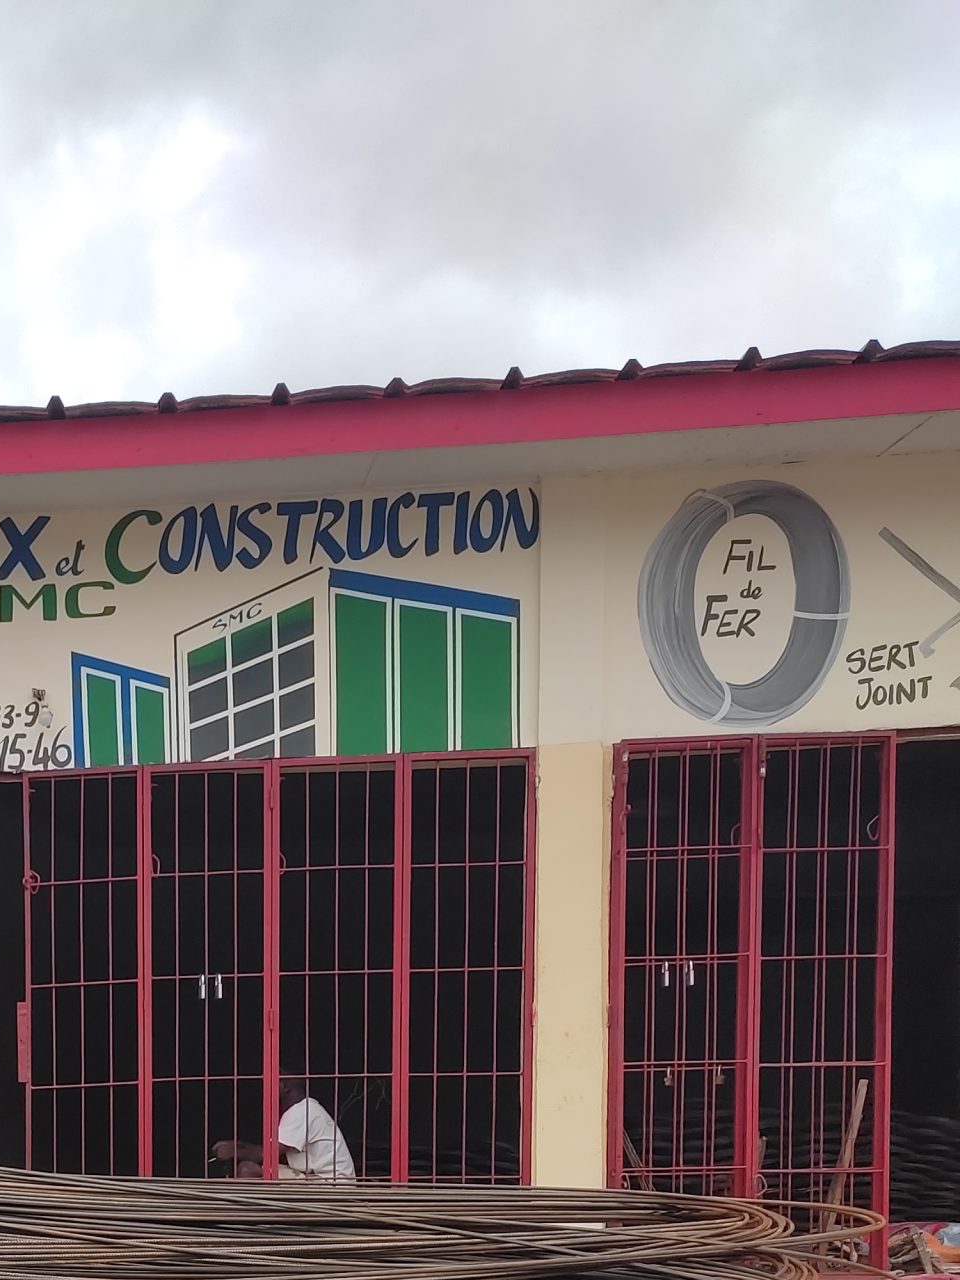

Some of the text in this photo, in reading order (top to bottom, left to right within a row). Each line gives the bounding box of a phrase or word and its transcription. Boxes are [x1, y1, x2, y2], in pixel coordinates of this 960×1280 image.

[55, 539, 85, 577] et
[104, 487, 539, 585] CONSTRUCTION
[723, 539, 777, 575] FIL
[739, 579, 764, 600] de
[212, 602, 263, 634] SMC
[700, 594, 762, 639] FER
[845, 640, 920, 675] SERT
[855, 675, 933, 710] JOINT
